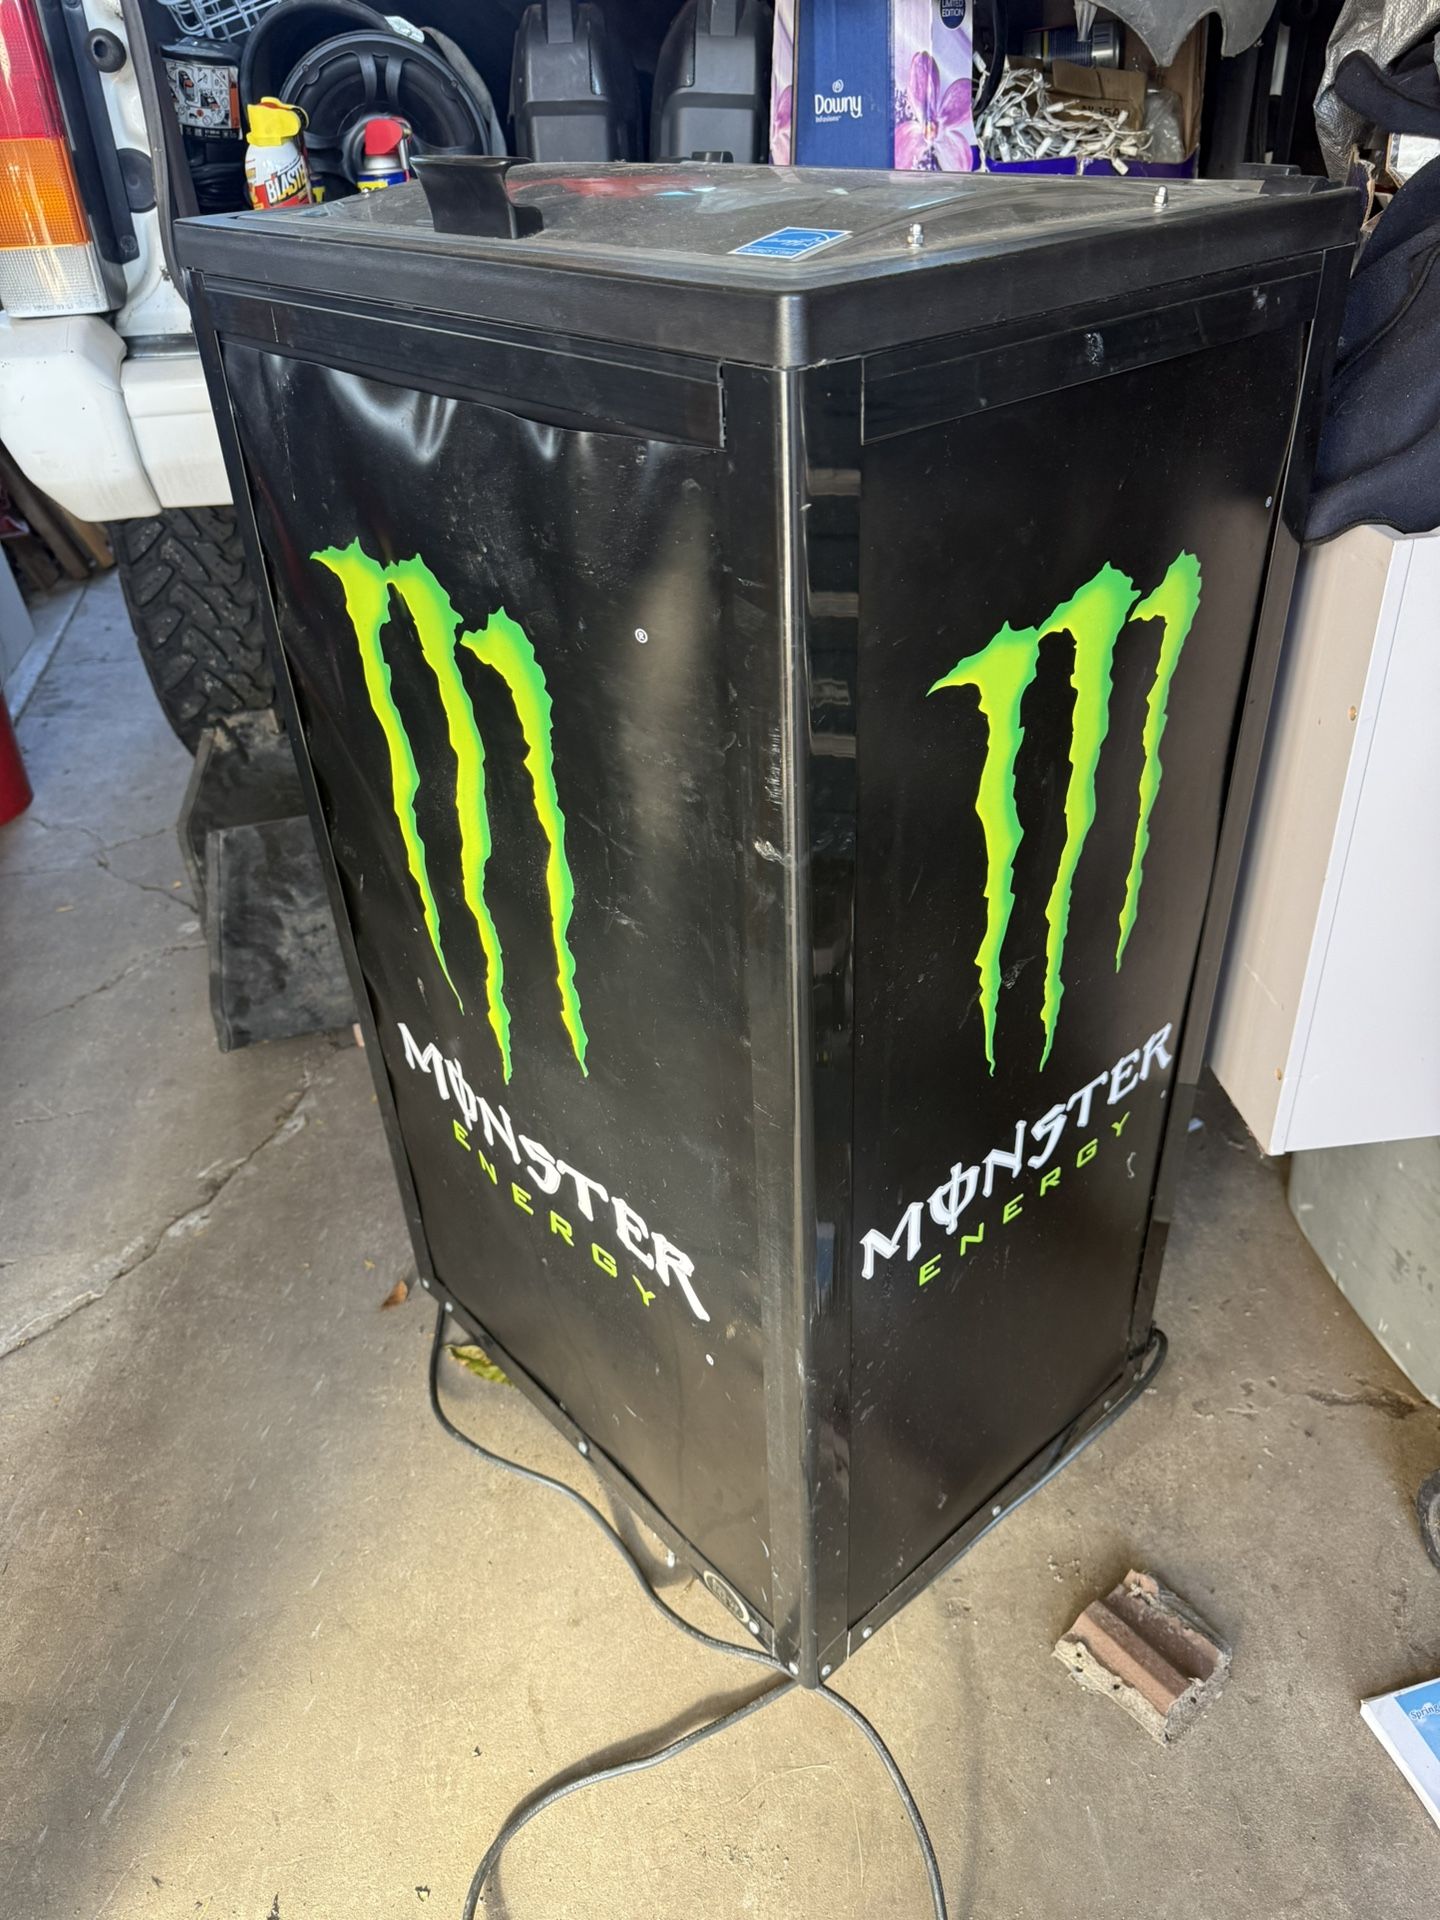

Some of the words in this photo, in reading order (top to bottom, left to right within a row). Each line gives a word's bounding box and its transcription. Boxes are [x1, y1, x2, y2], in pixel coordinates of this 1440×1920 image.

[941, 8, 964, 17] EDITION
[815, 94, 861, 119] Downy
[453, 1119, 656, 1307] ENERGY
[918, 1111, 1131, 1287] ENERGY
